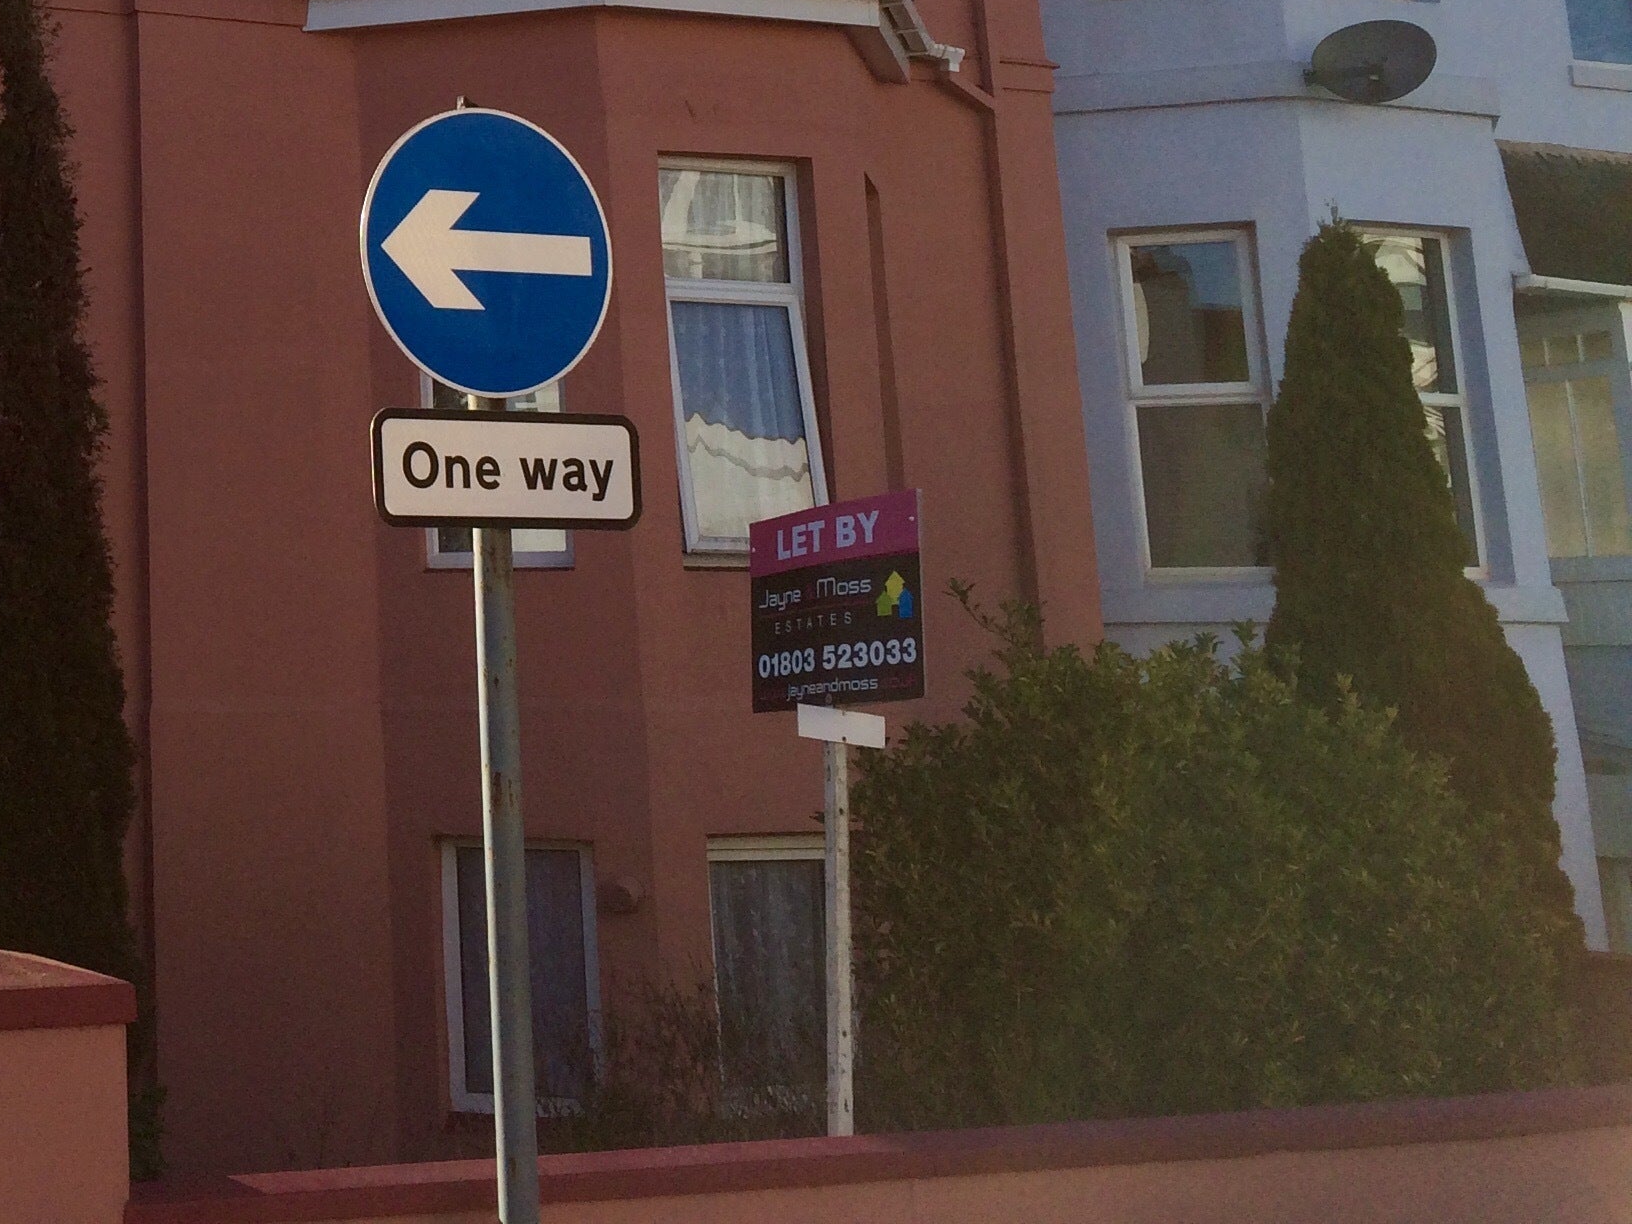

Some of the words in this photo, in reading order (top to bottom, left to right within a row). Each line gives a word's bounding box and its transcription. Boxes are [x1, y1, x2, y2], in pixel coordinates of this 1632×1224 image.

[402, 440, 501, 491] One
[519, 457, 614, 502] way
[776, 519, 826, 561] LET
[835, 509, 880, 549] BY
[758, 588, 802, 612] Jayne
[815, 576, 872, 599] Moss
[774, 611, 853, 635] ESTATES
[757, 647, 816, 679] 01803
[821, 636, 917, 670] 523033
